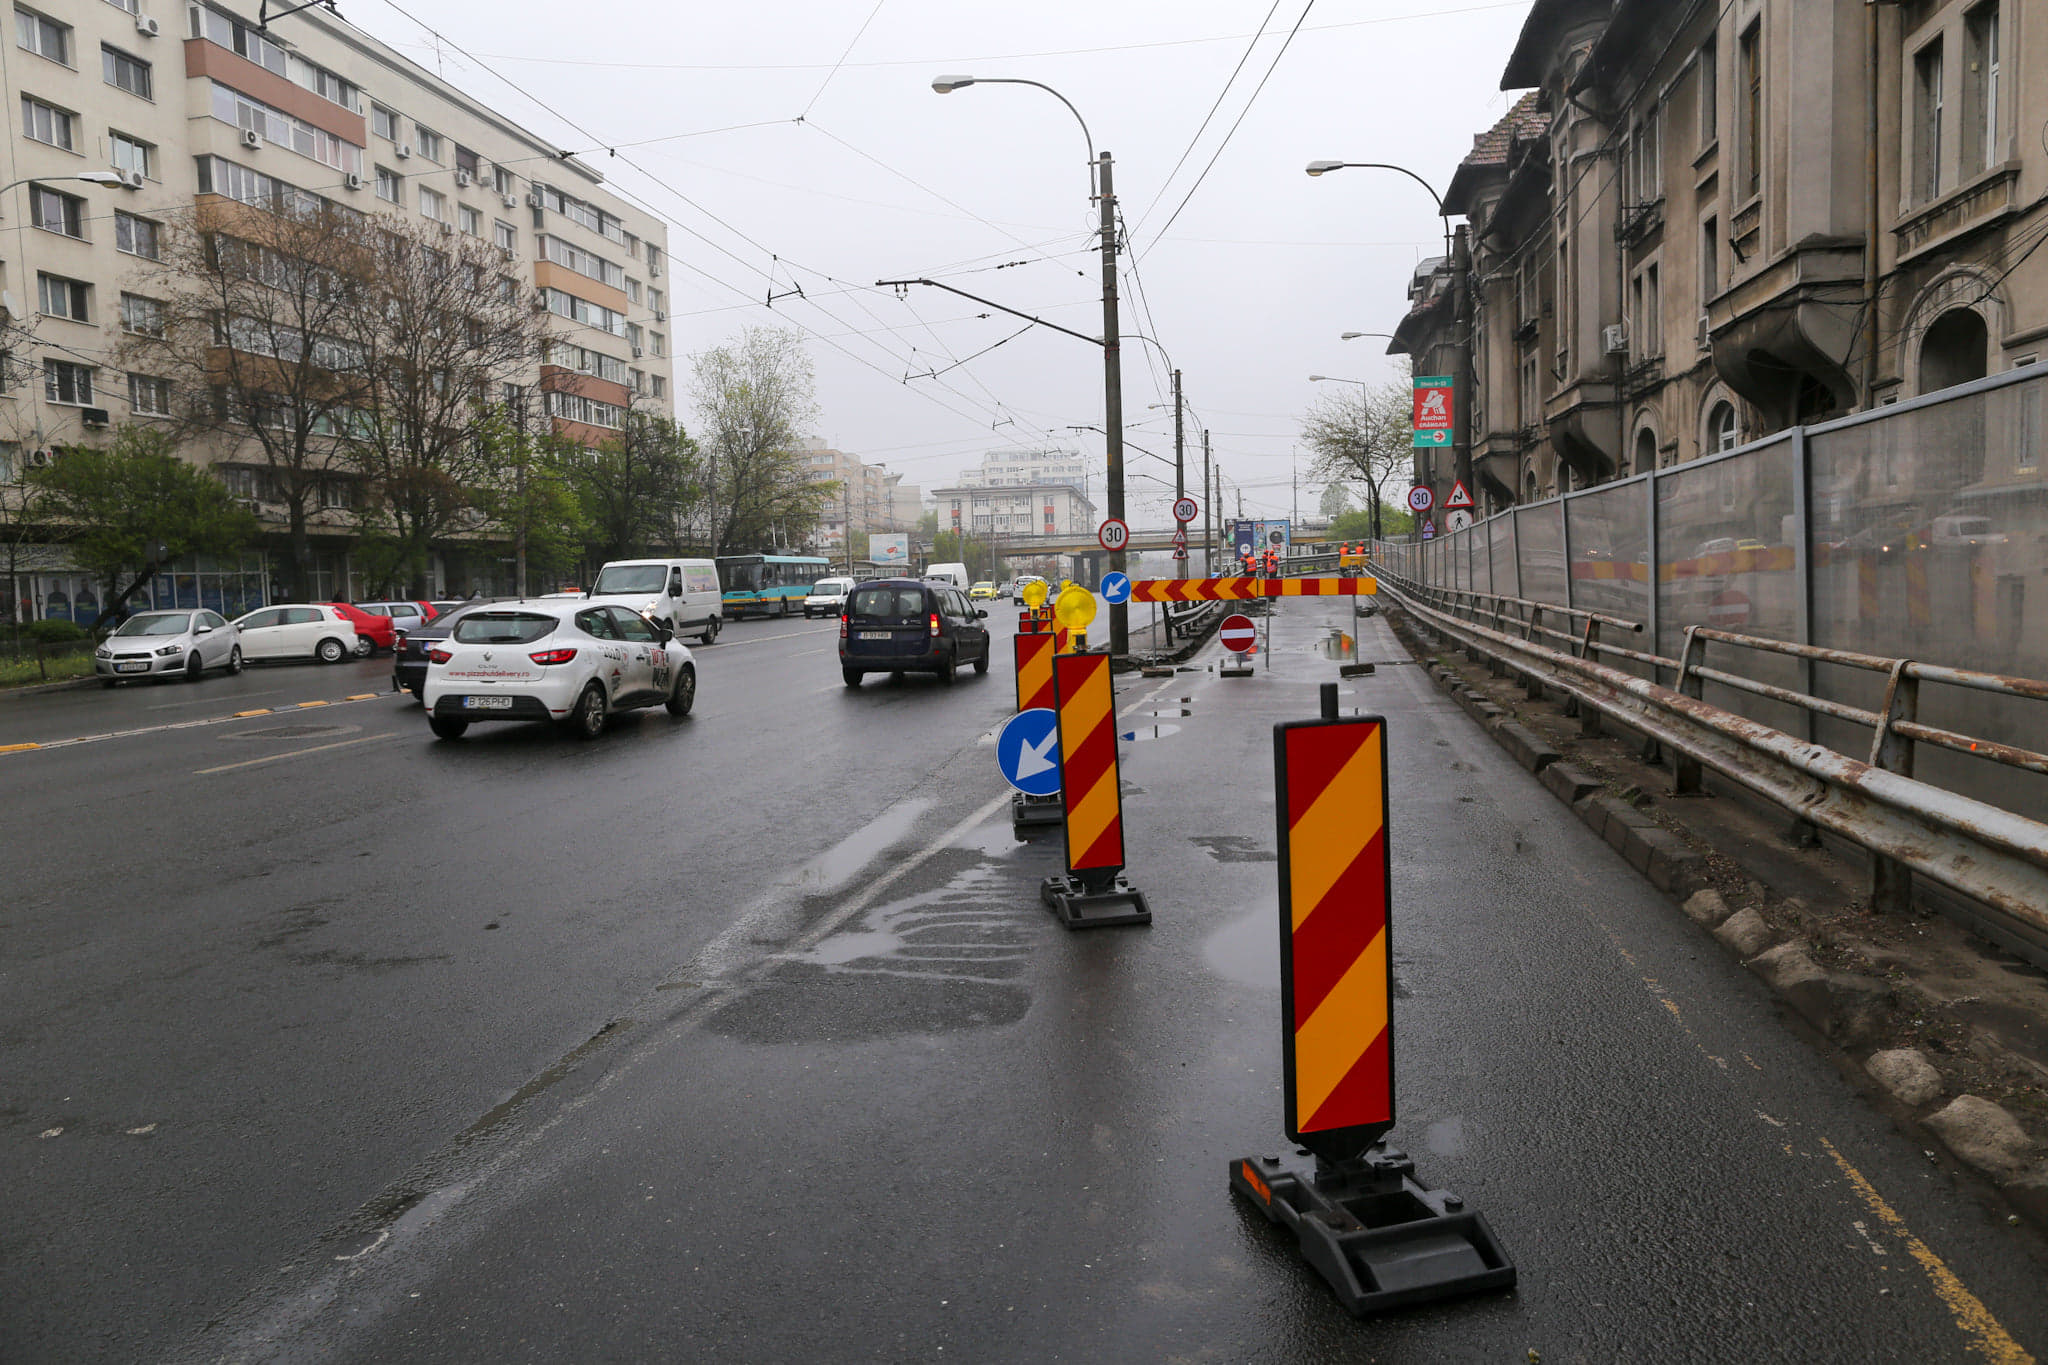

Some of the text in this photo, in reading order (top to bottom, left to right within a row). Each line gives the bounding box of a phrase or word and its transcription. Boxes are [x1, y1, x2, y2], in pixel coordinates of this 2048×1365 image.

[1414, 492, 1428, 505] 30
[1178, 504, 1192, 516] 30
[1106, 527, 1122, 542] 30
[448, 670, 531, 679] www.pizzahutdelivery.ro
[468, 696, 476, 706] B
